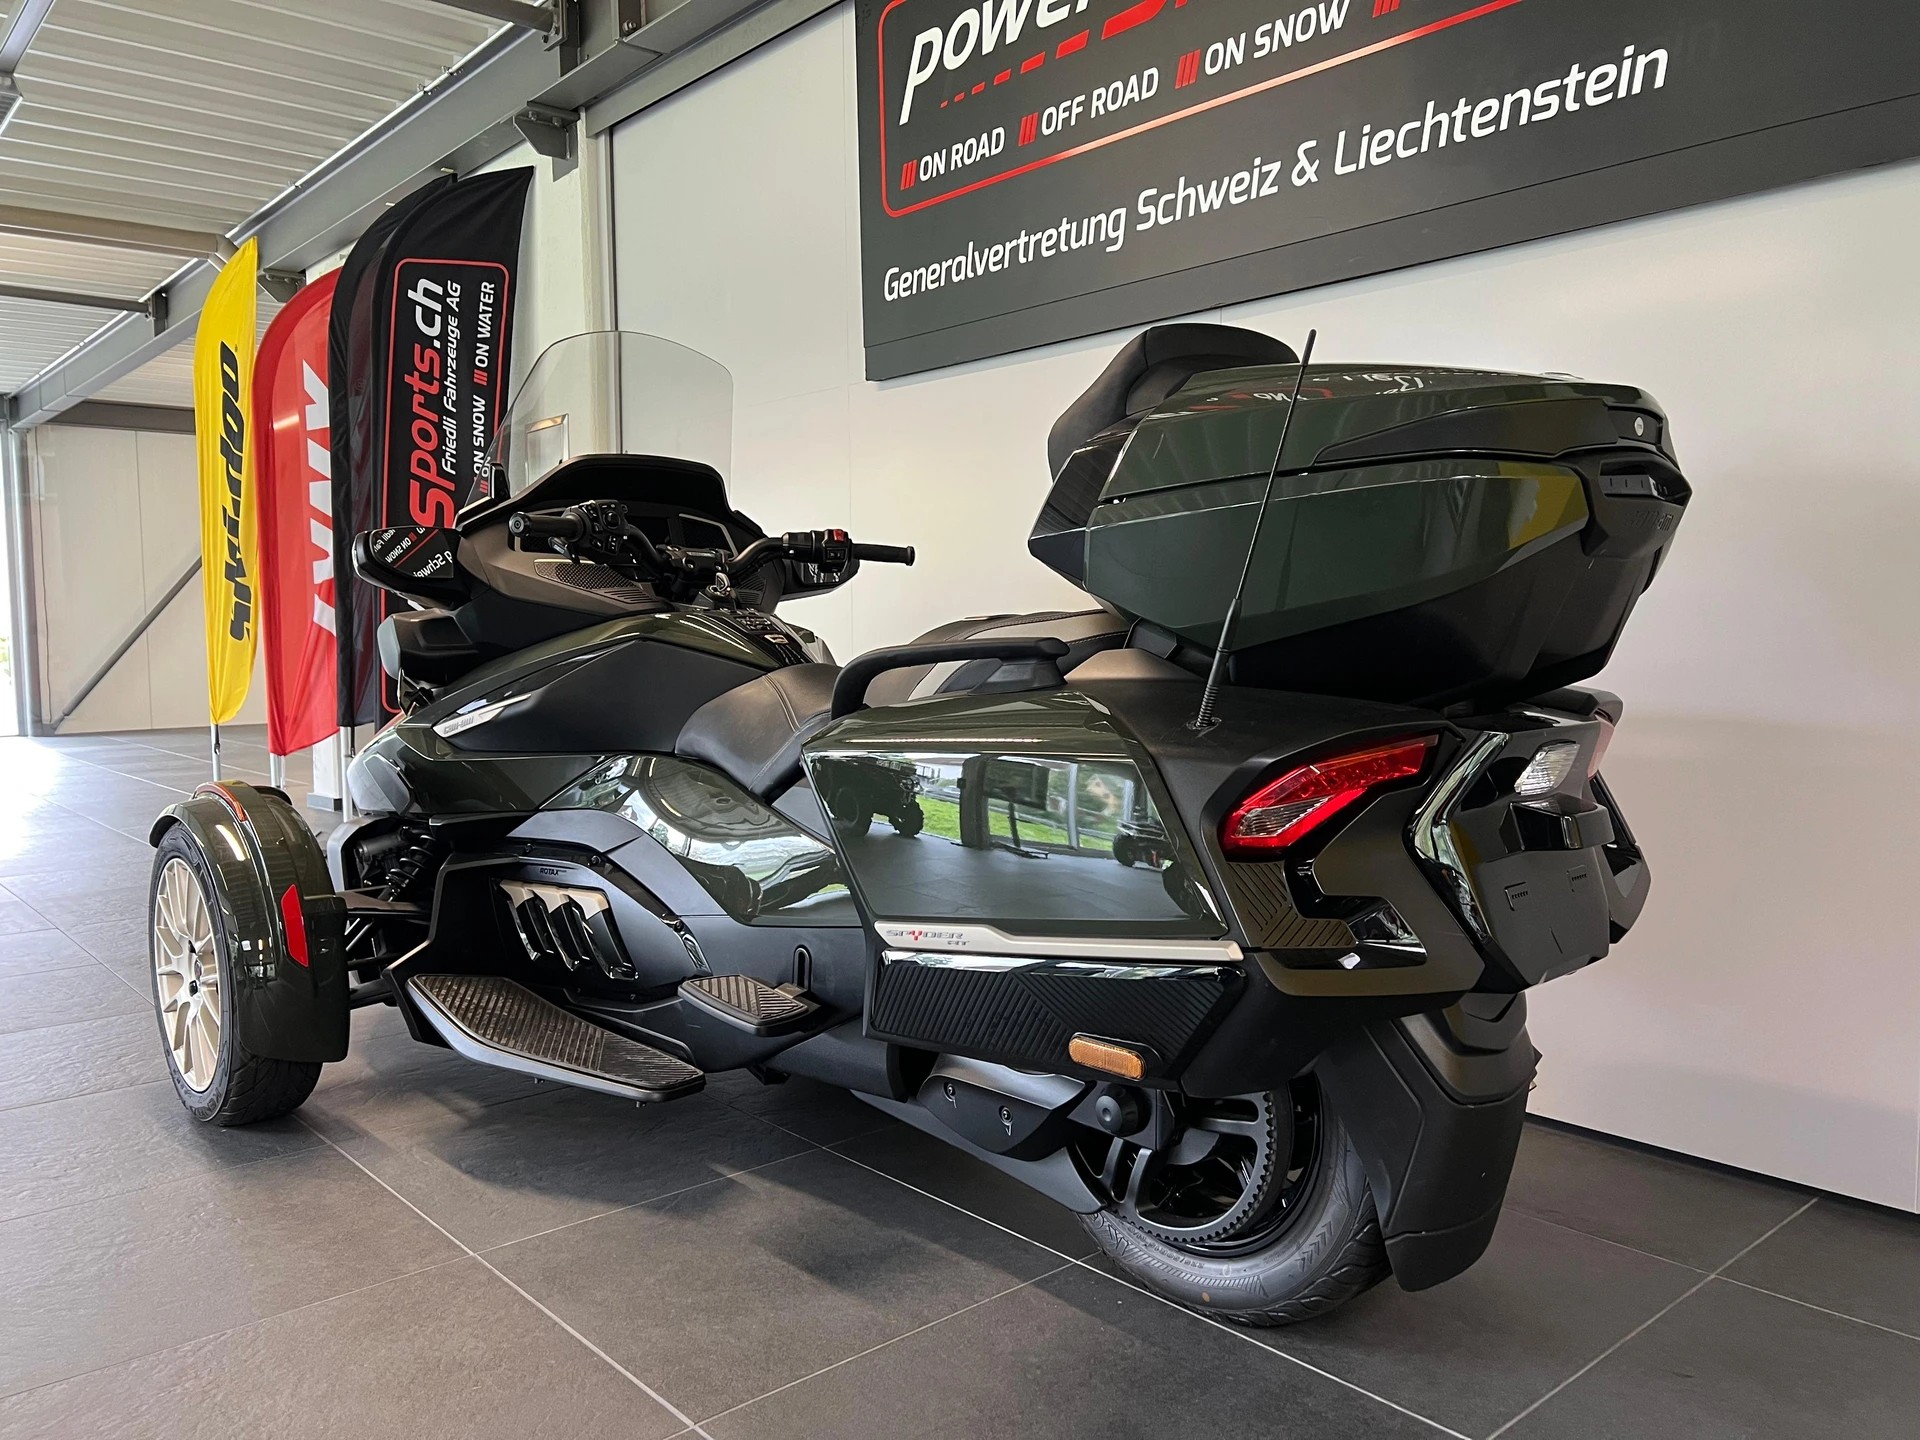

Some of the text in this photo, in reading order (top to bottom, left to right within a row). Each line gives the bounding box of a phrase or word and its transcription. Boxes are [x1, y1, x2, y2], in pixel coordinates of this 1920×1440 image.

[1204, 0, 1351, 76] ON SNOW
[1041, 67, 1159, 136] OFF ROAD
[884, 44, 1669, 302] Generalvertretung Schweiz & Liechtenstein
[919, 126, 1005, 182] ON ROAD
[475, 281, 495, 368] ON WATER
[442, 280, 461, 475] Friedli Fahrzeuge AG
[472, 394, 486, 448] SNOW
[886, 929, 964, 941] SPYDER
